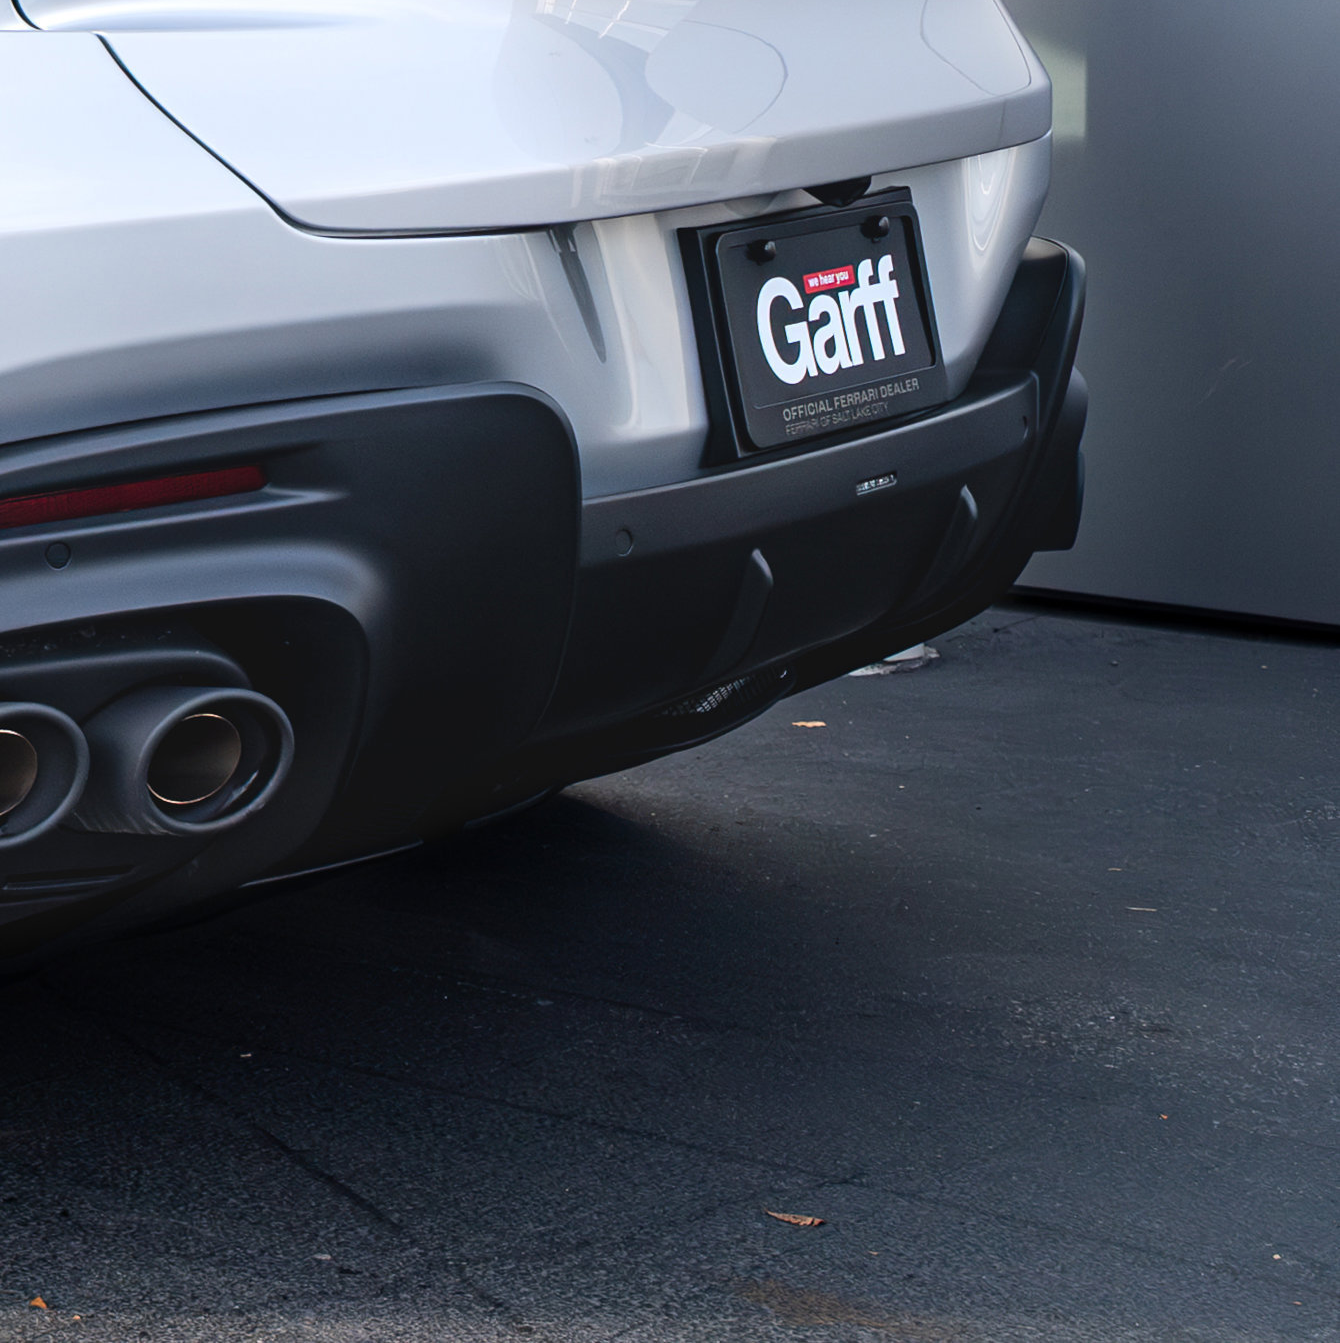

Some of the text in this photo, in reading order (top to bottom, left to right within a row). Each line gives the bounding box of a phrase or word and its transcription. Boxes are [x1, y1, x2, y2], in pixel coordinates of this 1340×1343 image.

[807, 270, 849, 288] we hear you
[757, 254, 906, 385] Garff
[783, 378, 920, 421] OFFICIAL FERRARI DEALER
